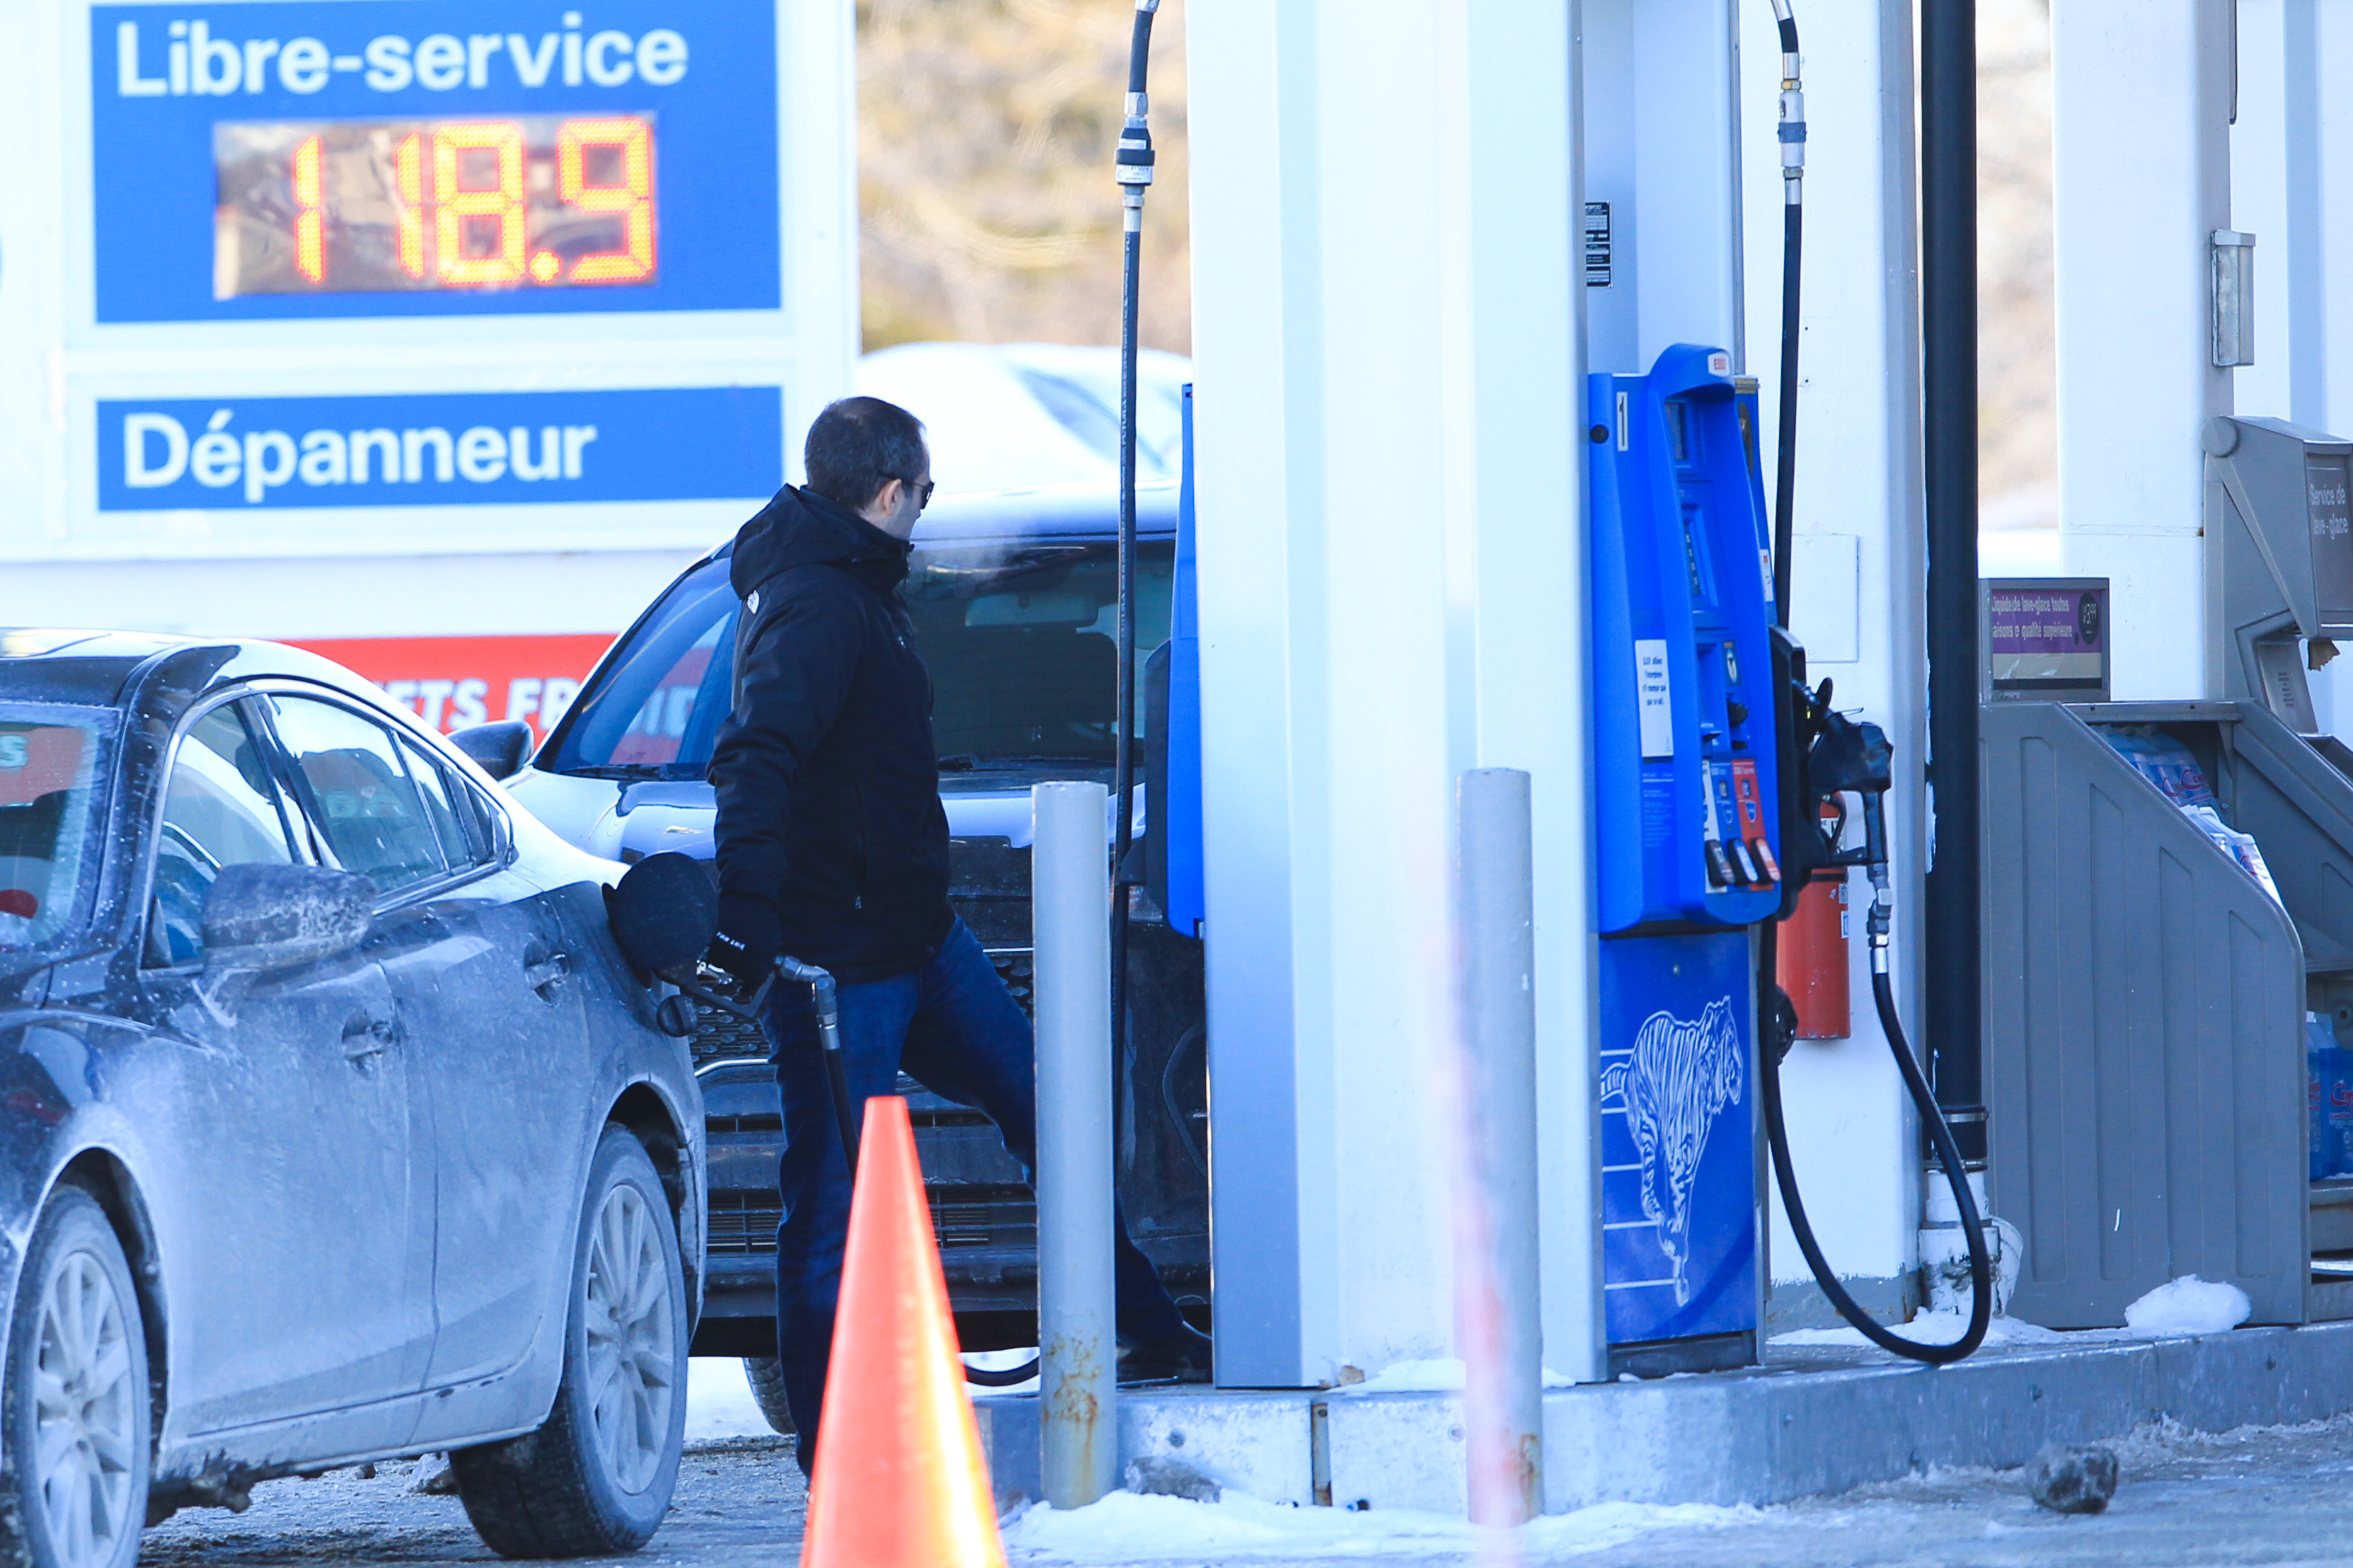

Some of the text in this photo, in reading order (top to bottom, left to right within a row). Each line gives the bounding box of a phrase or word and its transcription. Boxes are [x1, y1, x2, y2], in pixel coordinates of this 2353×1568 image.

[117, 11, 689, 98] Libre-service
[292, 117, 655, 287] 118.9
[123, 408, 598, 504] Dépanneur
[2310, 483, 2346, 506] Service de
